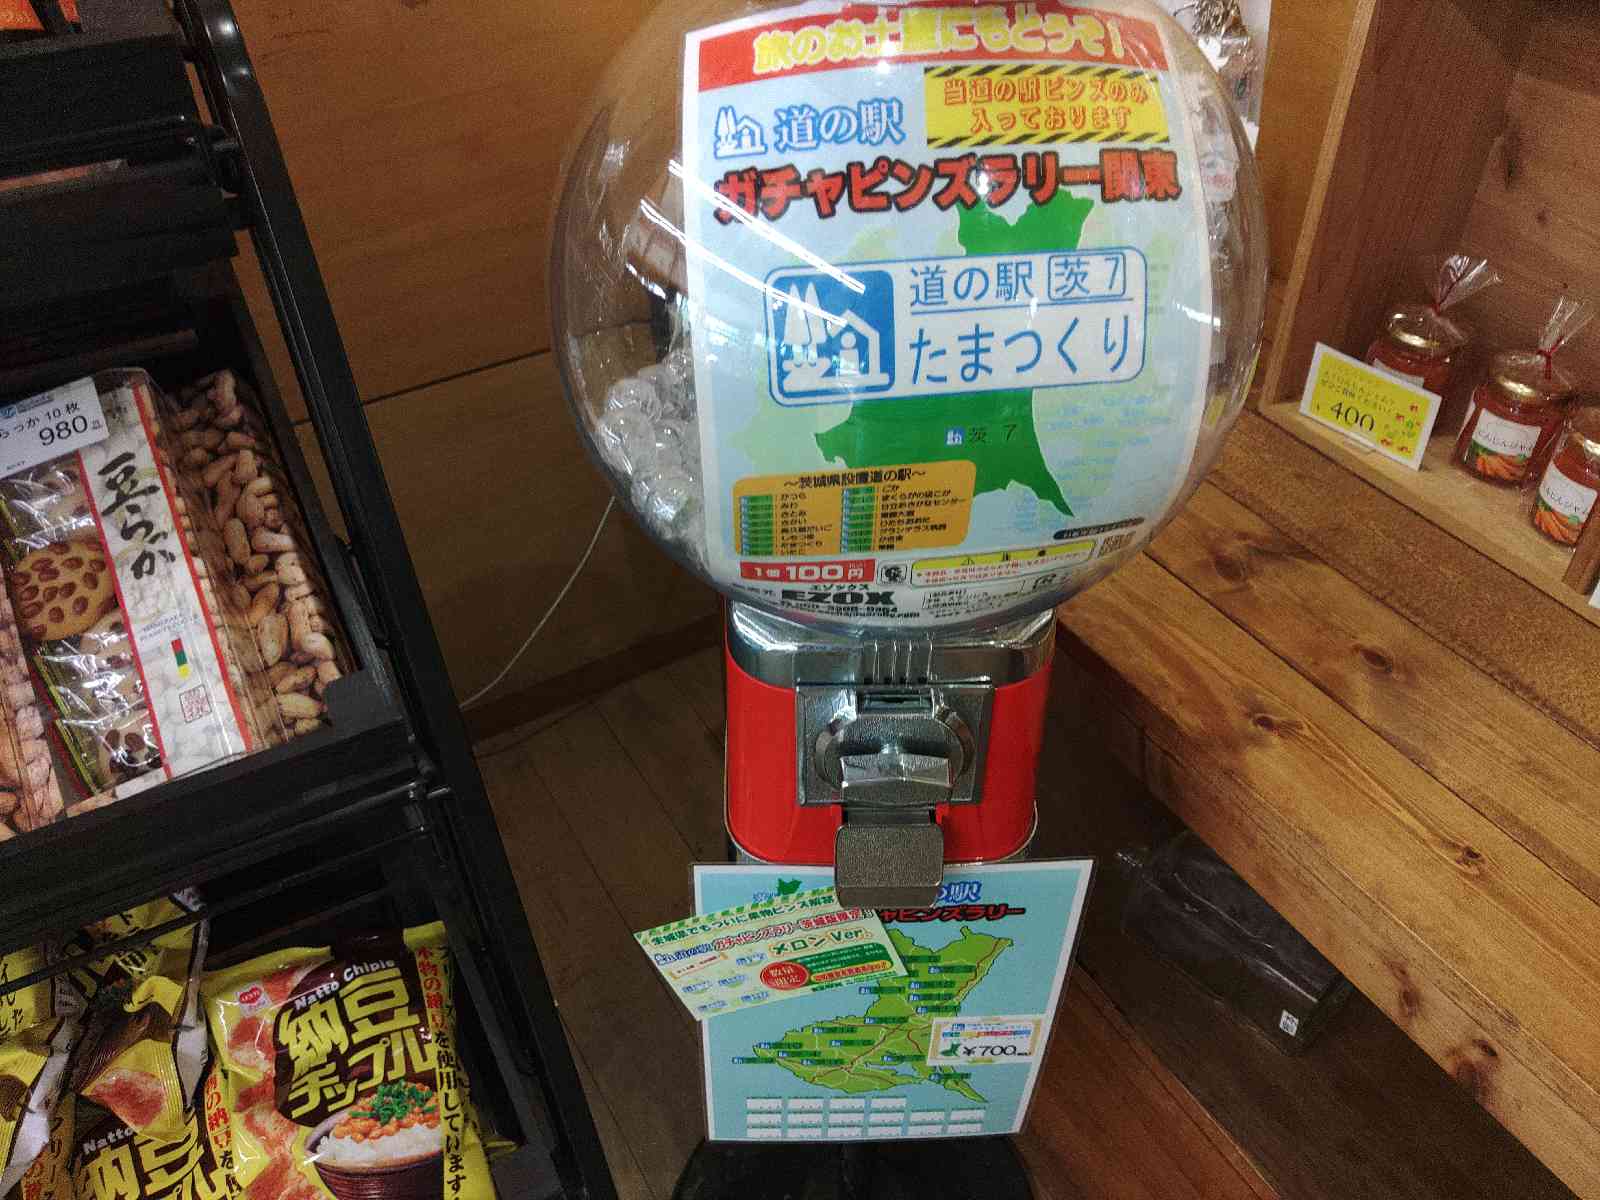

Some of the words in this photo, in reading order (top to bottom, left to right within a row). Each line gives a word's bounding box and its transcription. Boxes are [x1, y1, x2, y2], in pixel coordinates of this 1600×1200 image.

[943, 76, 1150, 106] 当道の駅ピンズのみ
[778, 99, 906, 152] 道の駅
[969, 105, 1133, 135] 入っております
[713, 148, 1184, 225] ガチャピンズラリー関東
[909, 260, 1034, 306] 道の駅
[909, 314, 1130, 386] たまつくり
[1329, 401, 1376, 432] 400
[781, 590, 897, 606] EZOX
[294, 981, 341, 1011] Natto
[279, 967, 421, 1082] 納豆
[287, 1028, 440, 1120] チップル
